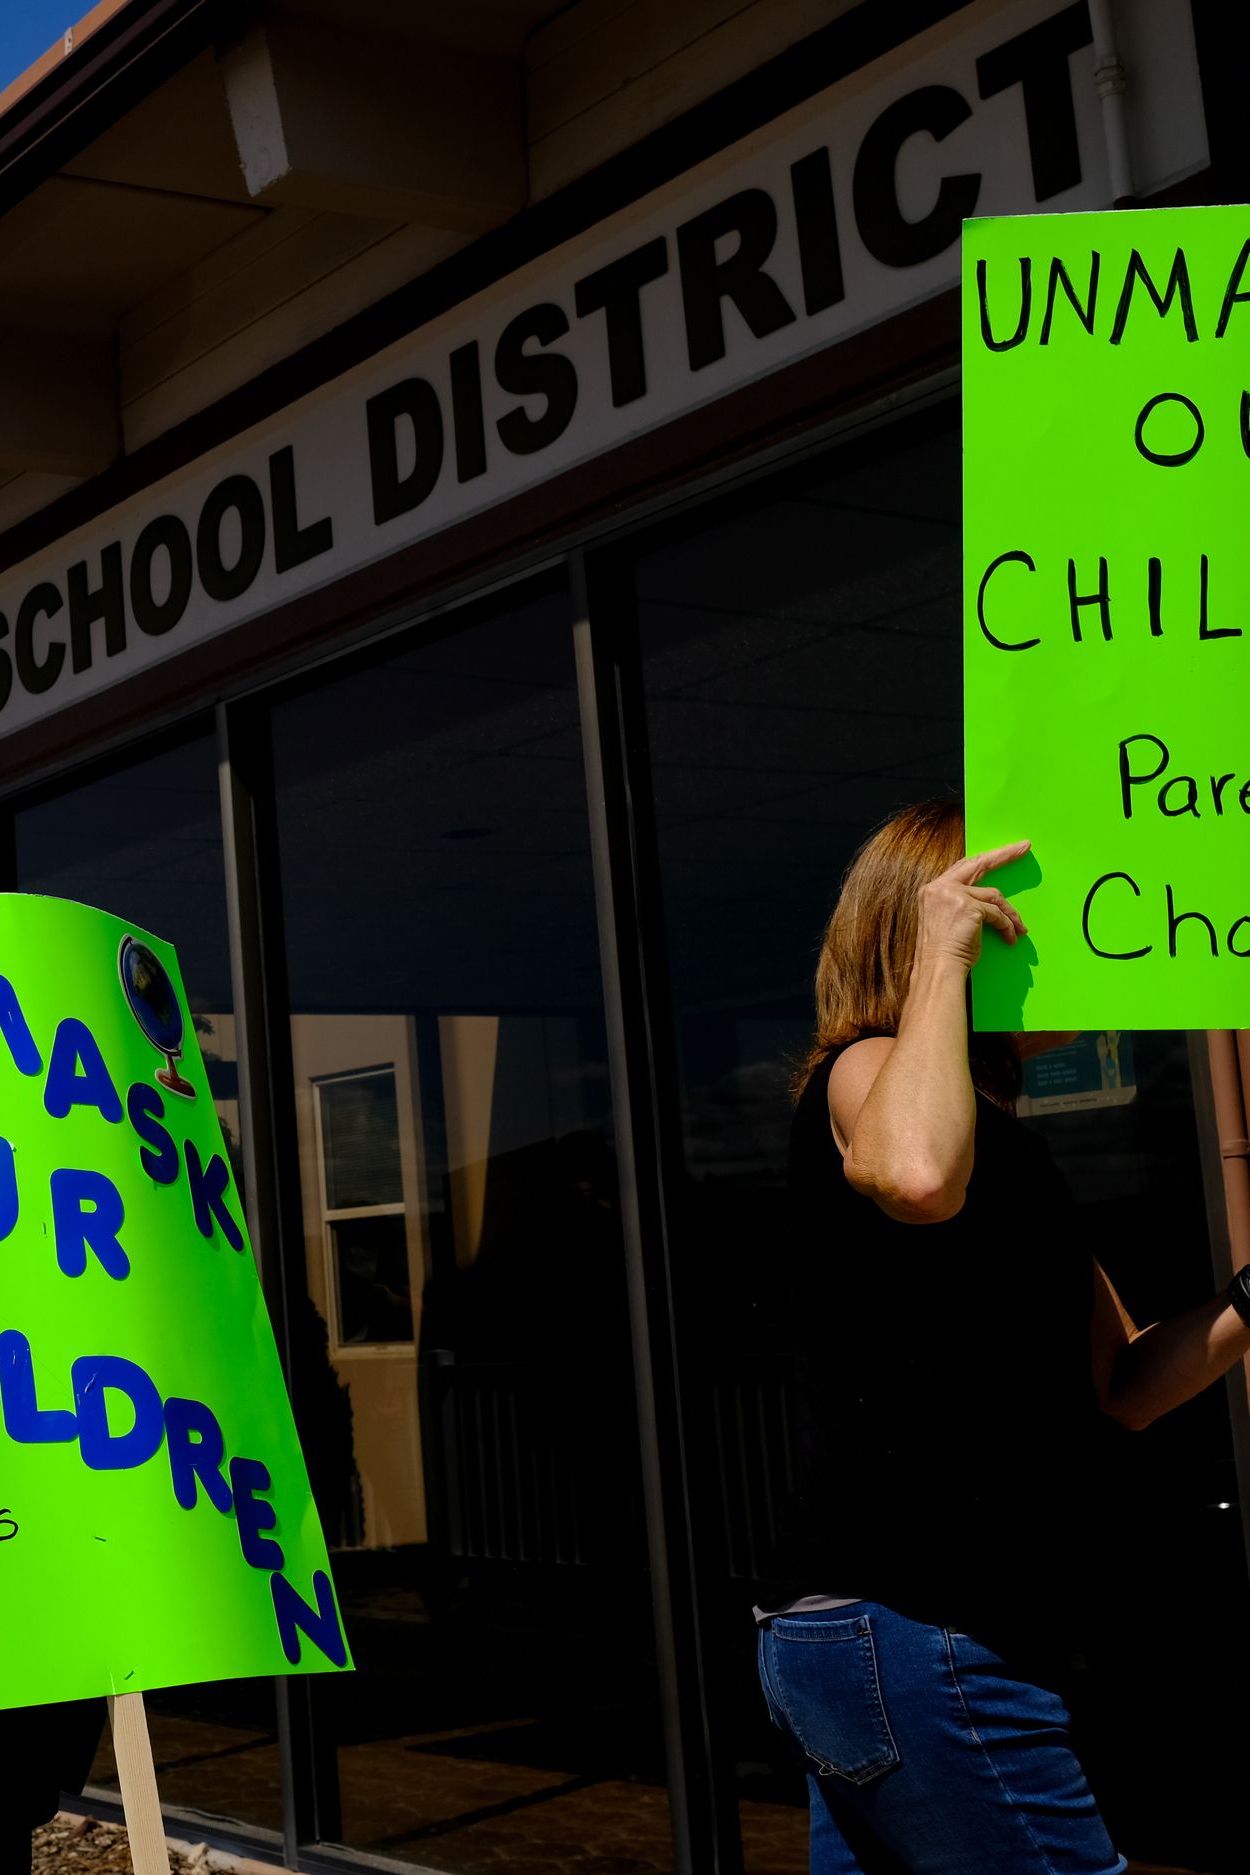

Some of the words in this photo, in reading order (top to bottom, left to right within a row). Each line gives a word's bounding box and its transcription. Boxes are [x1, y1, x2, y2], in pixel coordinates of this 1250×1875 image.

[366, 0, 1095, 526] DISTRICT
[1135, 391, 1250, 468] O
[977, 549, 1243, 652] CHIL
[1119, 733, 1250, 819] Par
